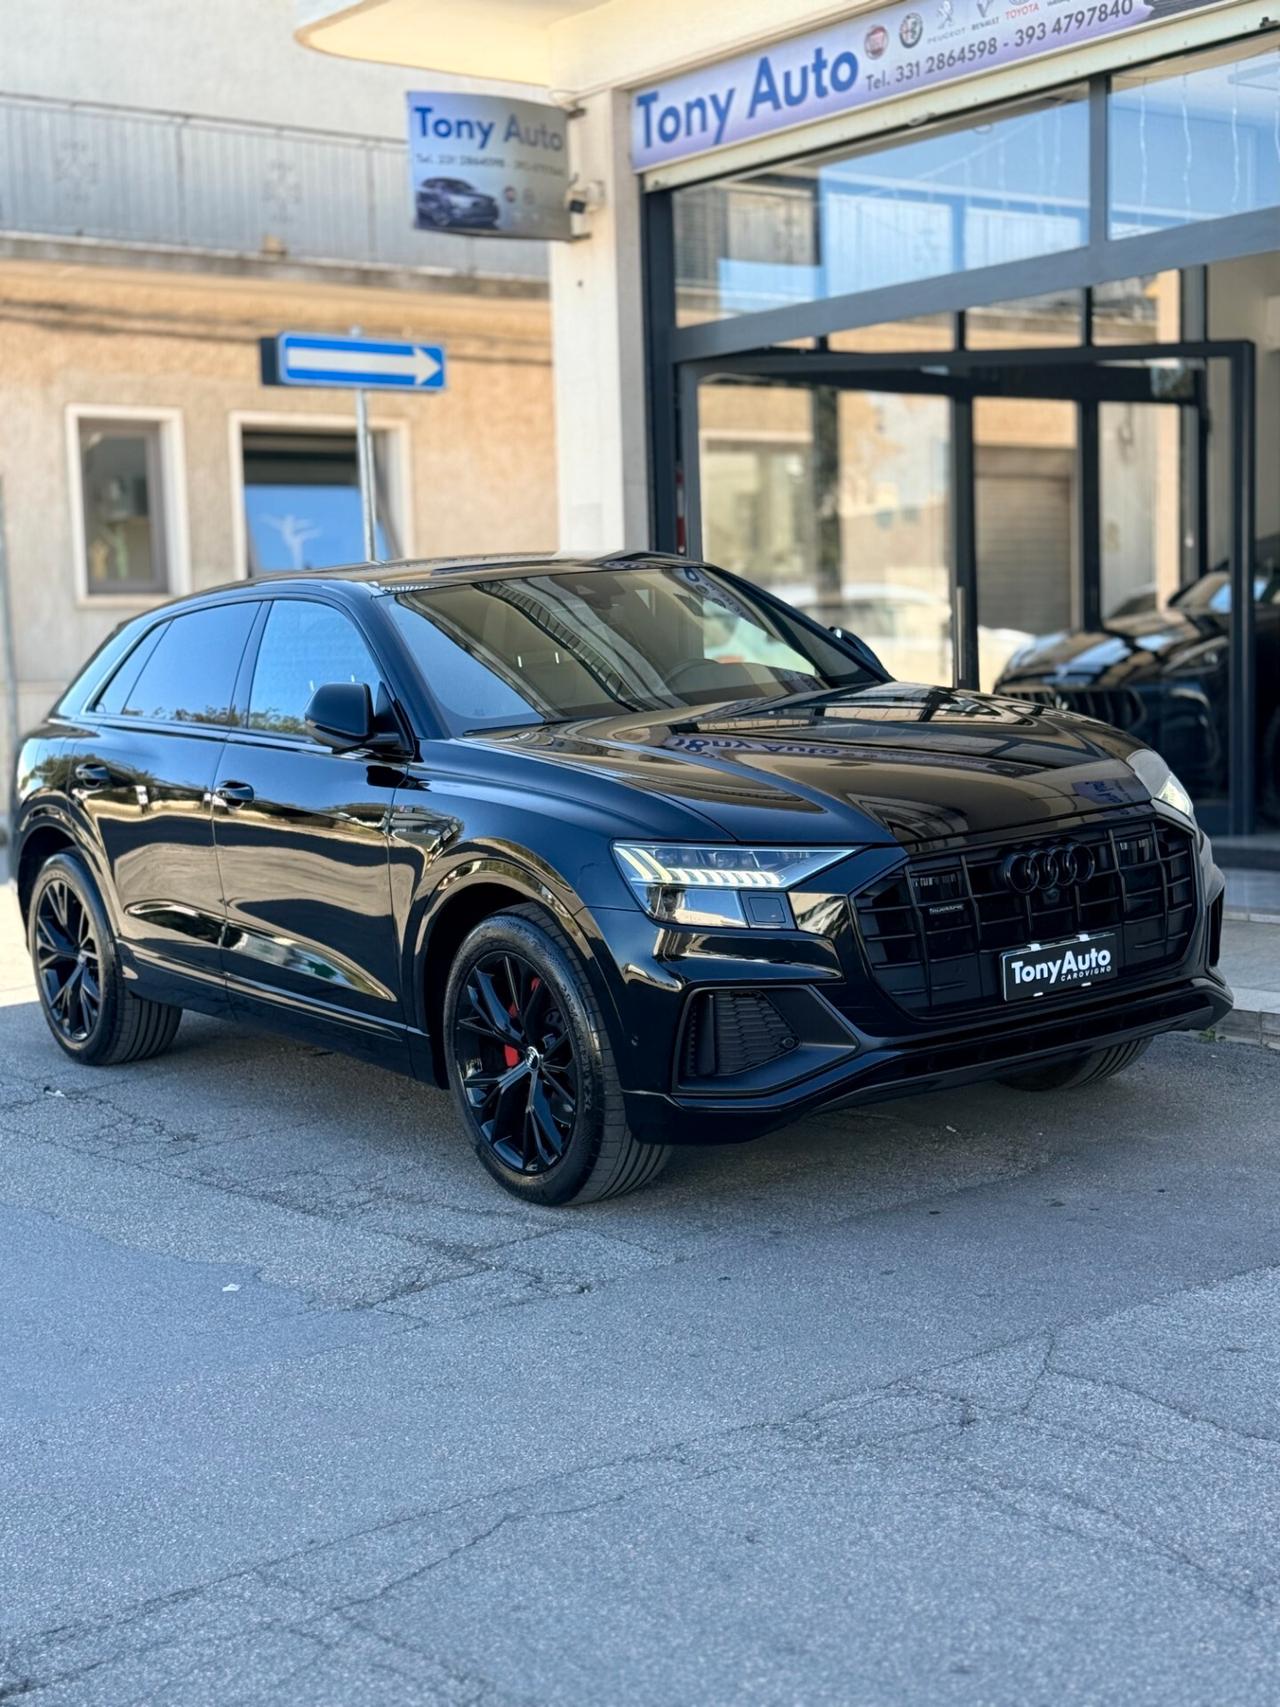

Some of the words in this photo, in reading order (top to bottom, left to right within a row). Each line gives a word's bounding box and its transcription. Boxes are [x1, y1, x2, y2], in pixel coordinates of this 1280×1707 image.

[1005, 3, 1039, 20] TOYOTA
[866, 70, 890, 91] Tel.
[896, 60, 920, 82] 331
[925, 37, 998, 75] 2864598
[1014, 22, 1046, 47] 393
[1051, 0, 1133, 34] 4797840
[636, 88, 736, 148] Tony
[747, 47, 859, 119] Auto
[414, 107, 494, 149] Tony
[503, 113, 564, 151] Auto
[1011, 948, 1111, 984] TonyAuto
[1060, 965, 1112, 982] CAROVIGNO
